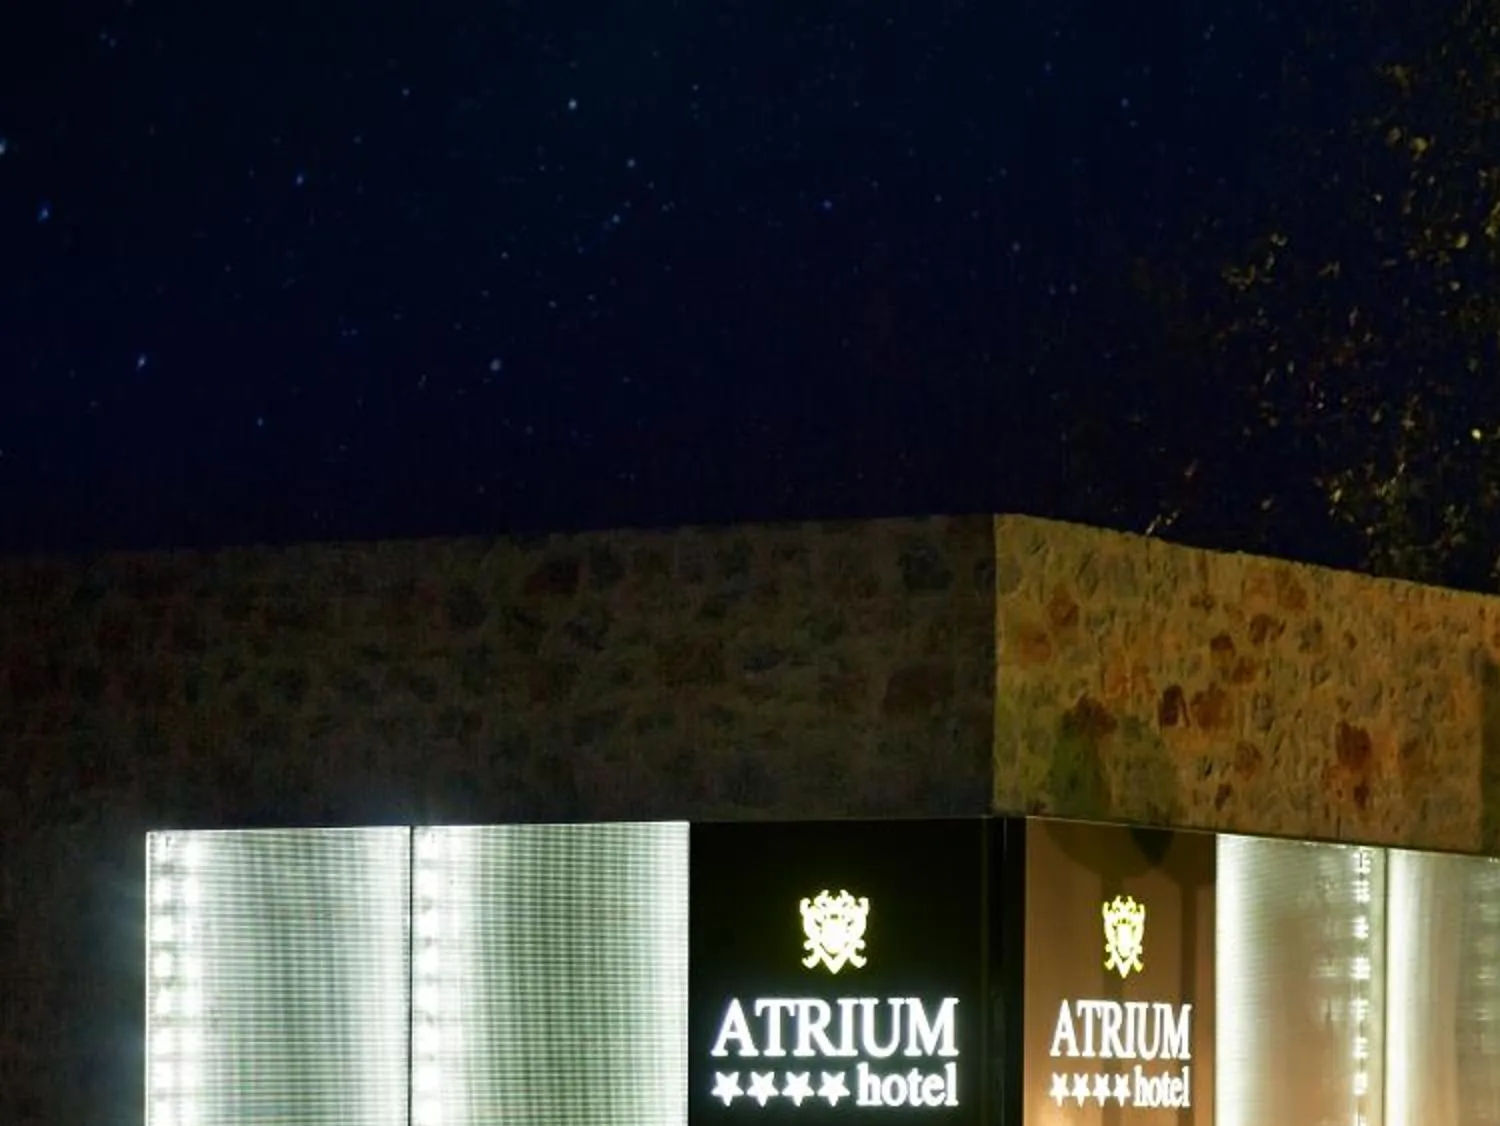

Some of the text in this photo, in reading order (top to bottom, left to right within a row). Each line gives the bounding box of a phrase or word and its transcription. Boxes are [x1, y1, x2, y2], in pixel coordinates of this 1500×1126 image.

[711, 997, 960, 1057] ATRIUM
[1050, 998, 1193, 1060] ATRIUM
[855, 1062, 960, 1108] hotel
[1132, 1064, 1192, 1109] hotel
